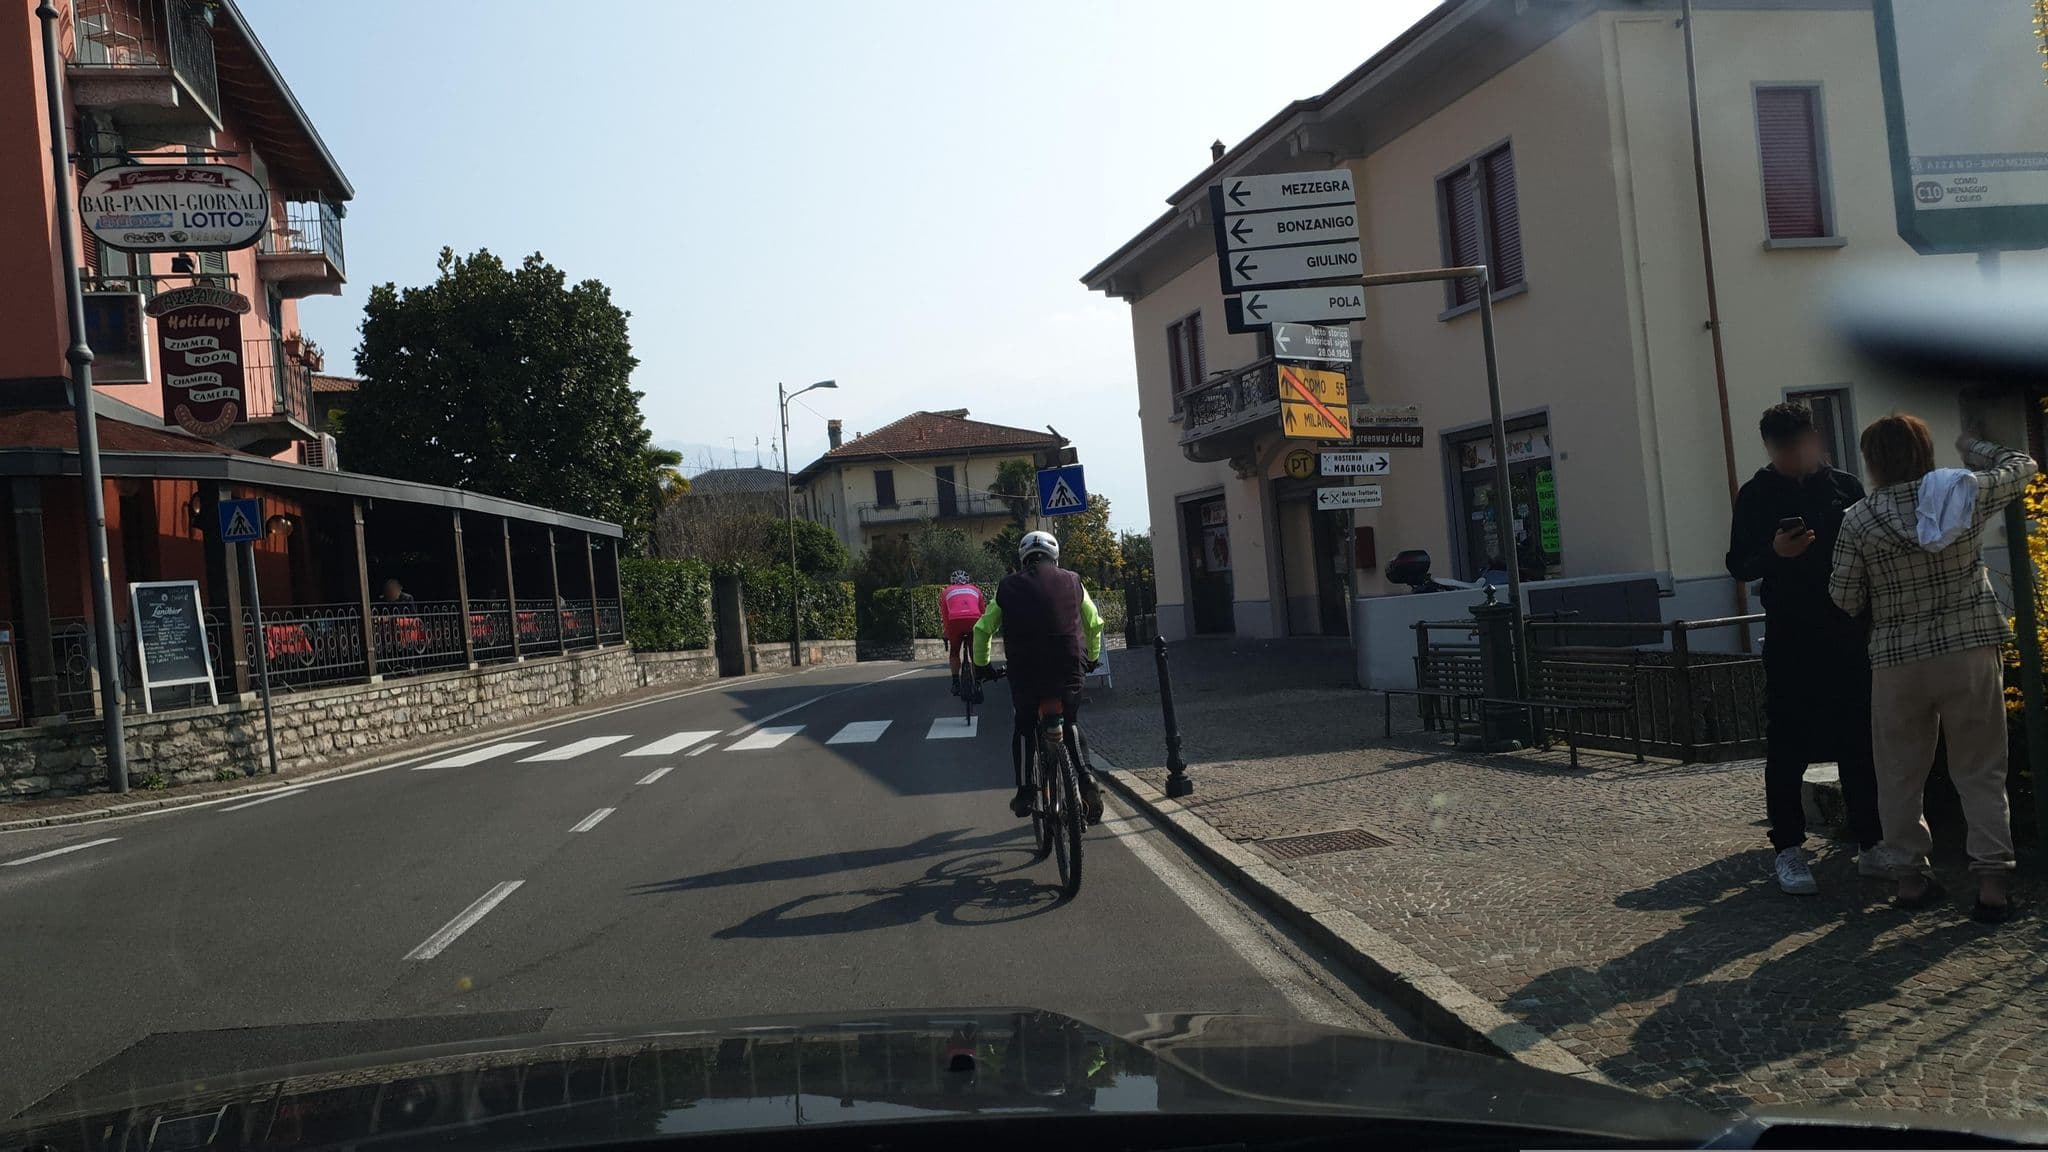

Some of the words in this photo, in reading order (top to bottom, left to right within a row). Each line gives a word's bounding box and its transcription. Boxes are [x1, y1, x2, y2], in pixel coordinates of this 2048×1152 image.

[1953, 177, 1978, 185] COMO
[1281, 180, 1350, 196] MEZZEGRA
[1917, 186, 1942, 199] C10
[82, 192, 264, 212] BAR-PANINI-GIORNALI
[182, 211, 244, 228] LOTTO
[1277, 215, 1354, 233] BONZANIGO
[1307, 253, 1357, 268] GIULINO
[1329, 296, 1361, 308] POLA
[168, 314, 230, 330] Holidays
[170, 338, 214, 349] ZIMMER
[1305, 336, 1333, 346] historical
[1334, 337, 1349, 348] sight
[194, 353, 230, 365] ROOM
[173, 375, 218, 386] CHAMBRES
[1303, 377, 1327, 394] COMO
[1335, 381, 1345, 396] 55
[193, 389, 235, 401] CAMERE
[1356, 434, 1389, 445] greenway
[1391, 433, 1403, 443] del
[1404, 433, 1420, 445] lago
[1291, 458, 1309, 473] PT
[1334, 464, 1375, 473] MAGNOLIA
